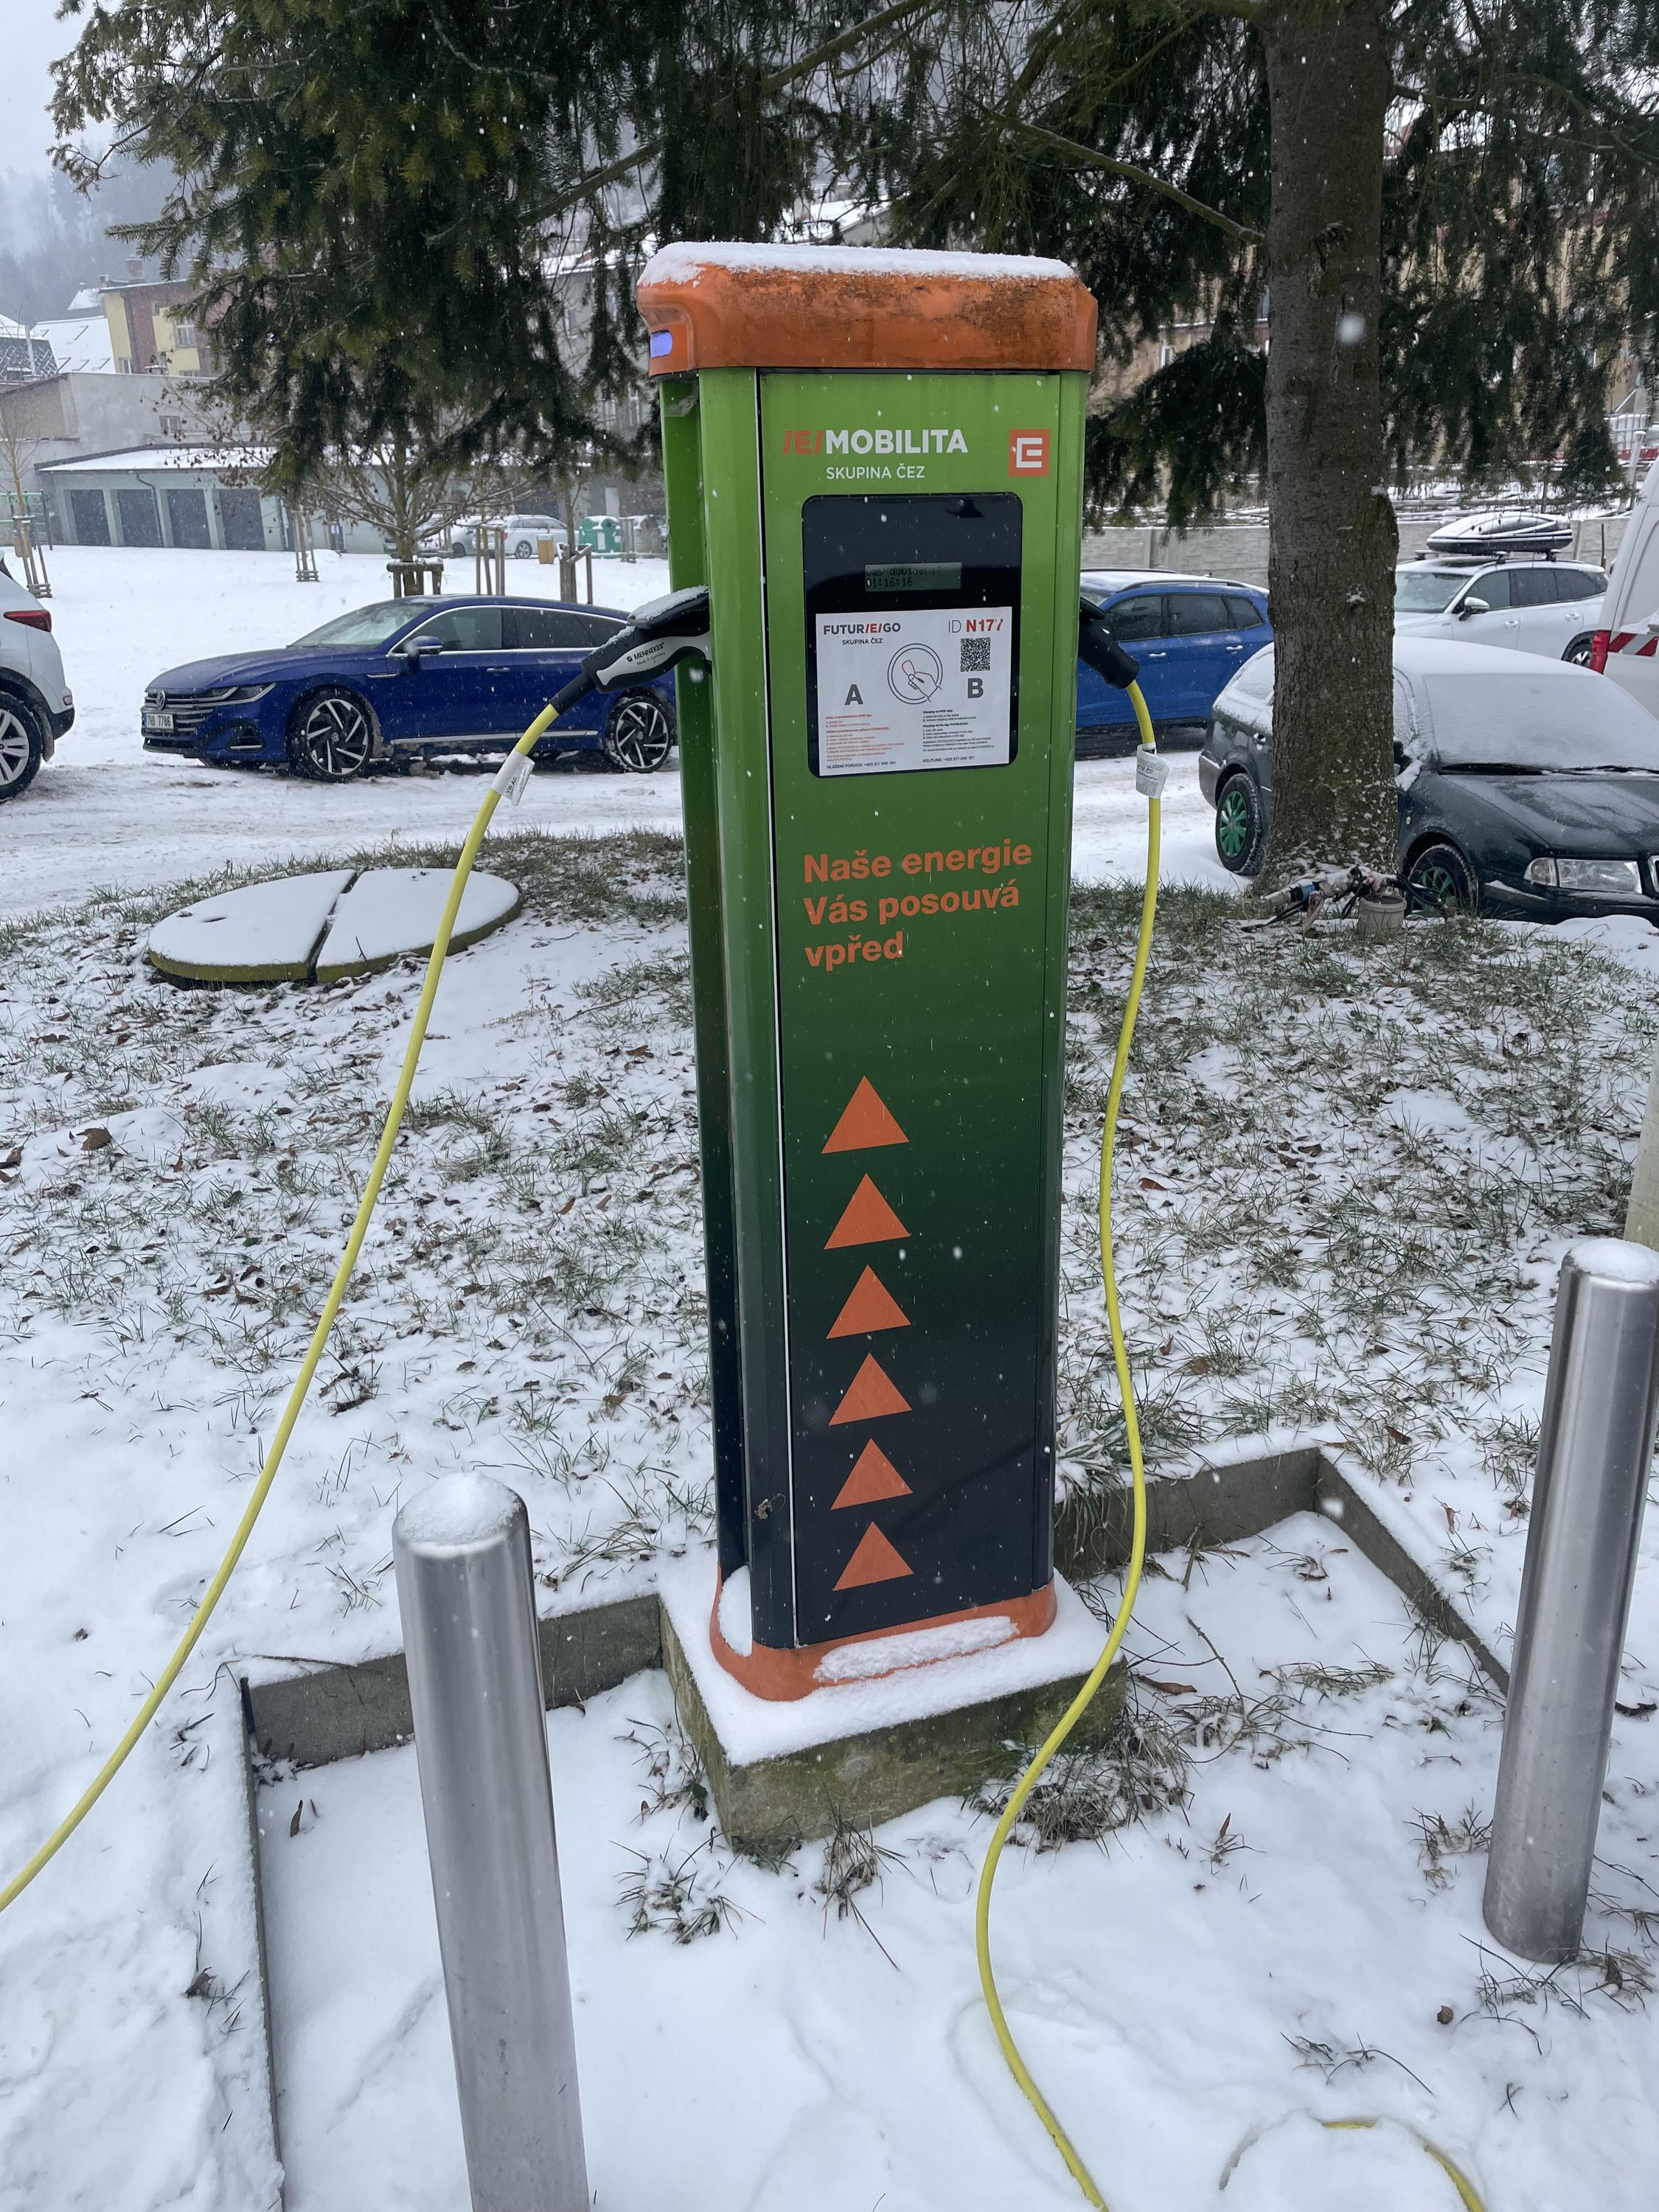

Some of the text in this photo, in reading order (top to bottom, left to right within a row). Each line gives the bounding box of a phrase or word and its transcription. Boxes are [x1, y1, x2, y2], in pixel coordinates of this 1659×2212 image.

[826, 463, 925, 479] SKUPINA ČEZ
[823, 622, 901, 635] FUTUR/E/GO
[948, 619, 961, 633] ID
[844, 684, 863, 706] A
[967, 678, 984, 699] B
[804, 838, 1032, 883] Naše energie
[803, 878, 1020, 925] Vás posouvá
[804, 931, 903, 972] vpřed
